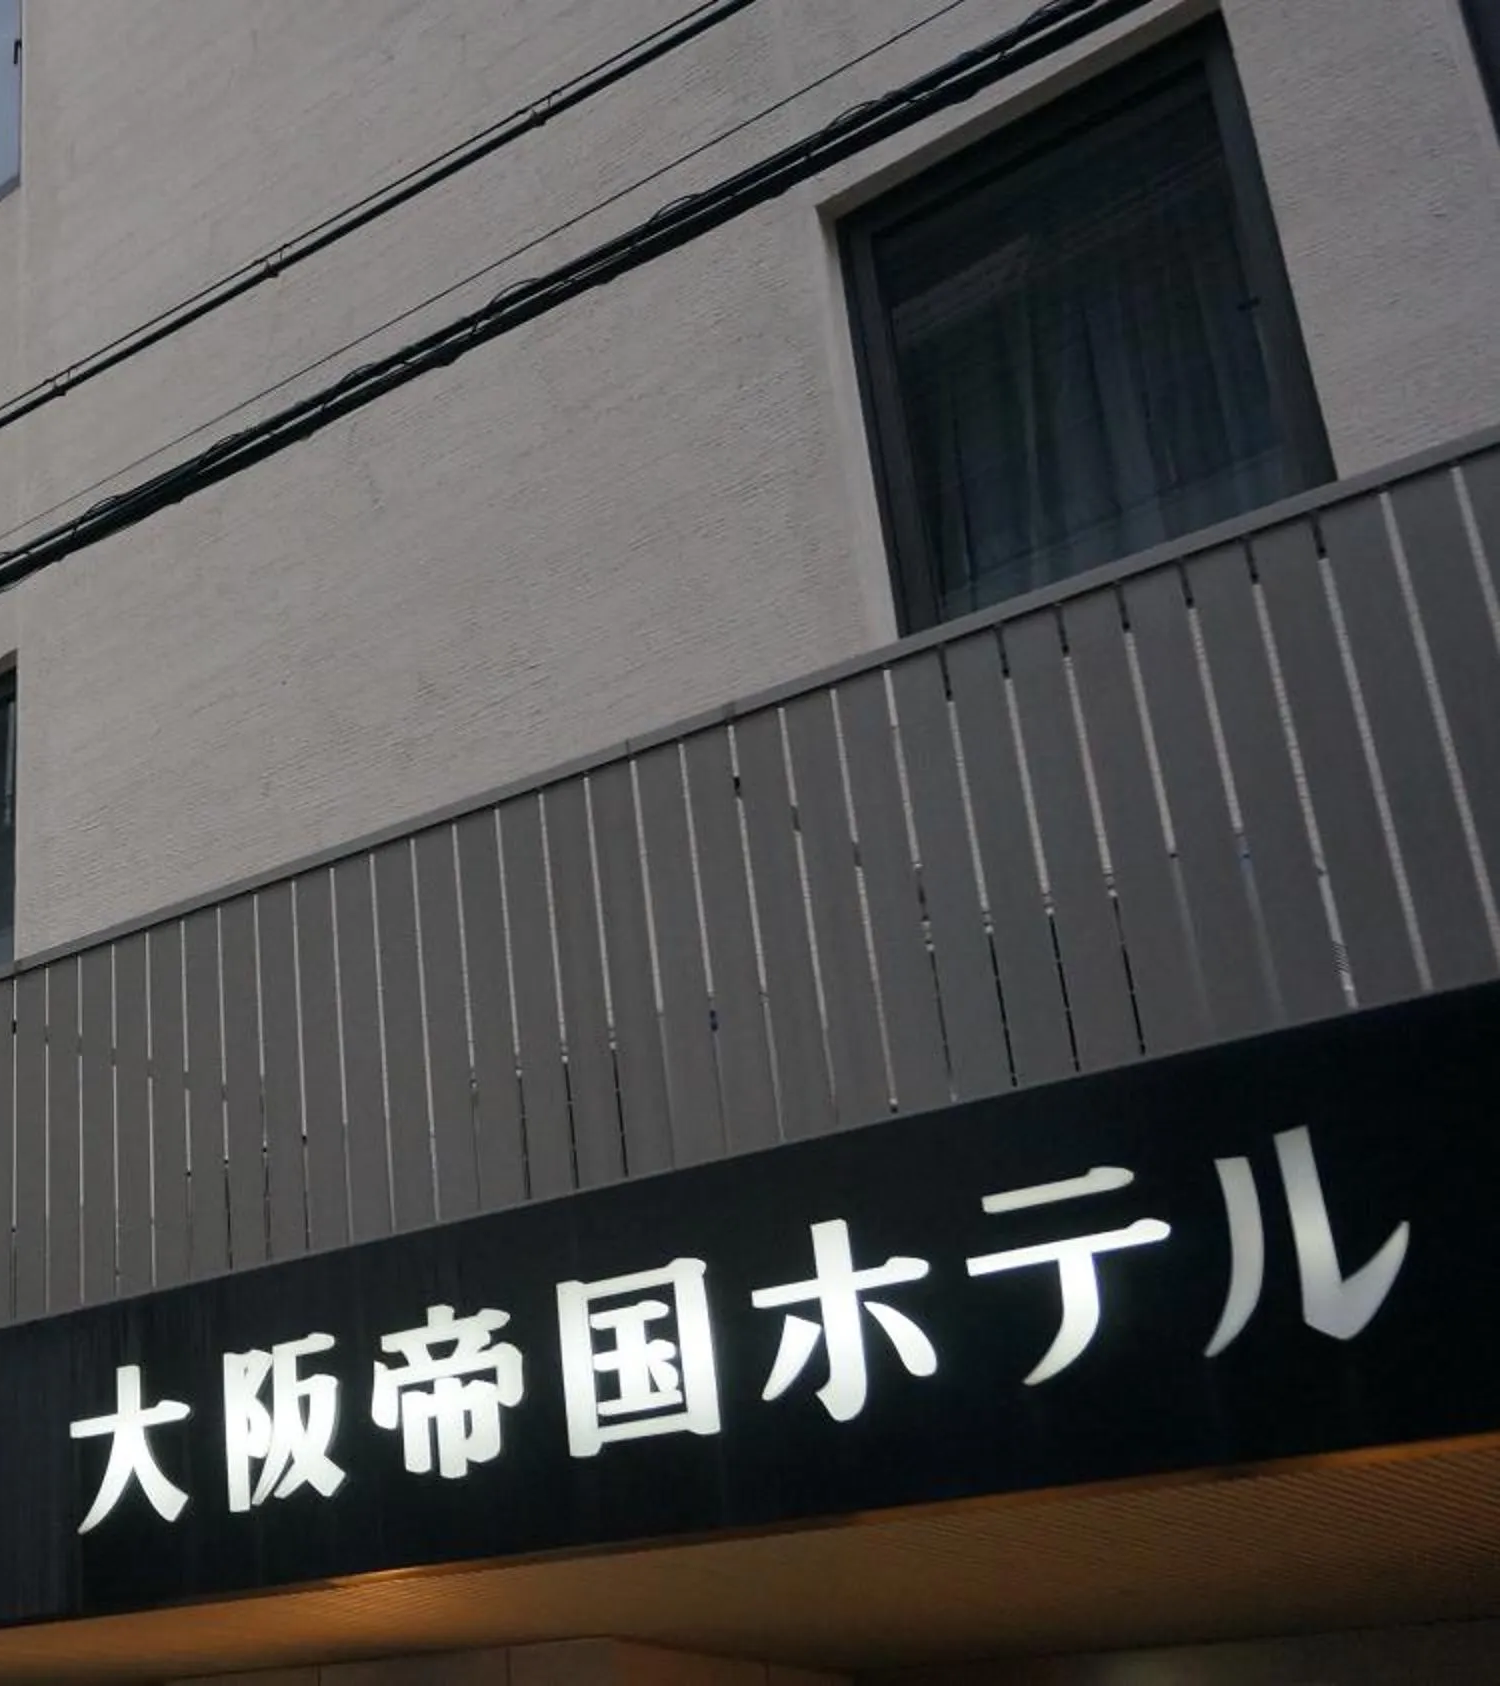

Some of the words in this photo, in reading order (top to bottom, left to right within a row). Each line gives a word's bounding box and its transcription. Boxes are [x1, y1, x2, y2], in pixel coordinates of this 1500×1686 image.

[70, 1126, 1410, 1532] 大阪帝国ホテル
